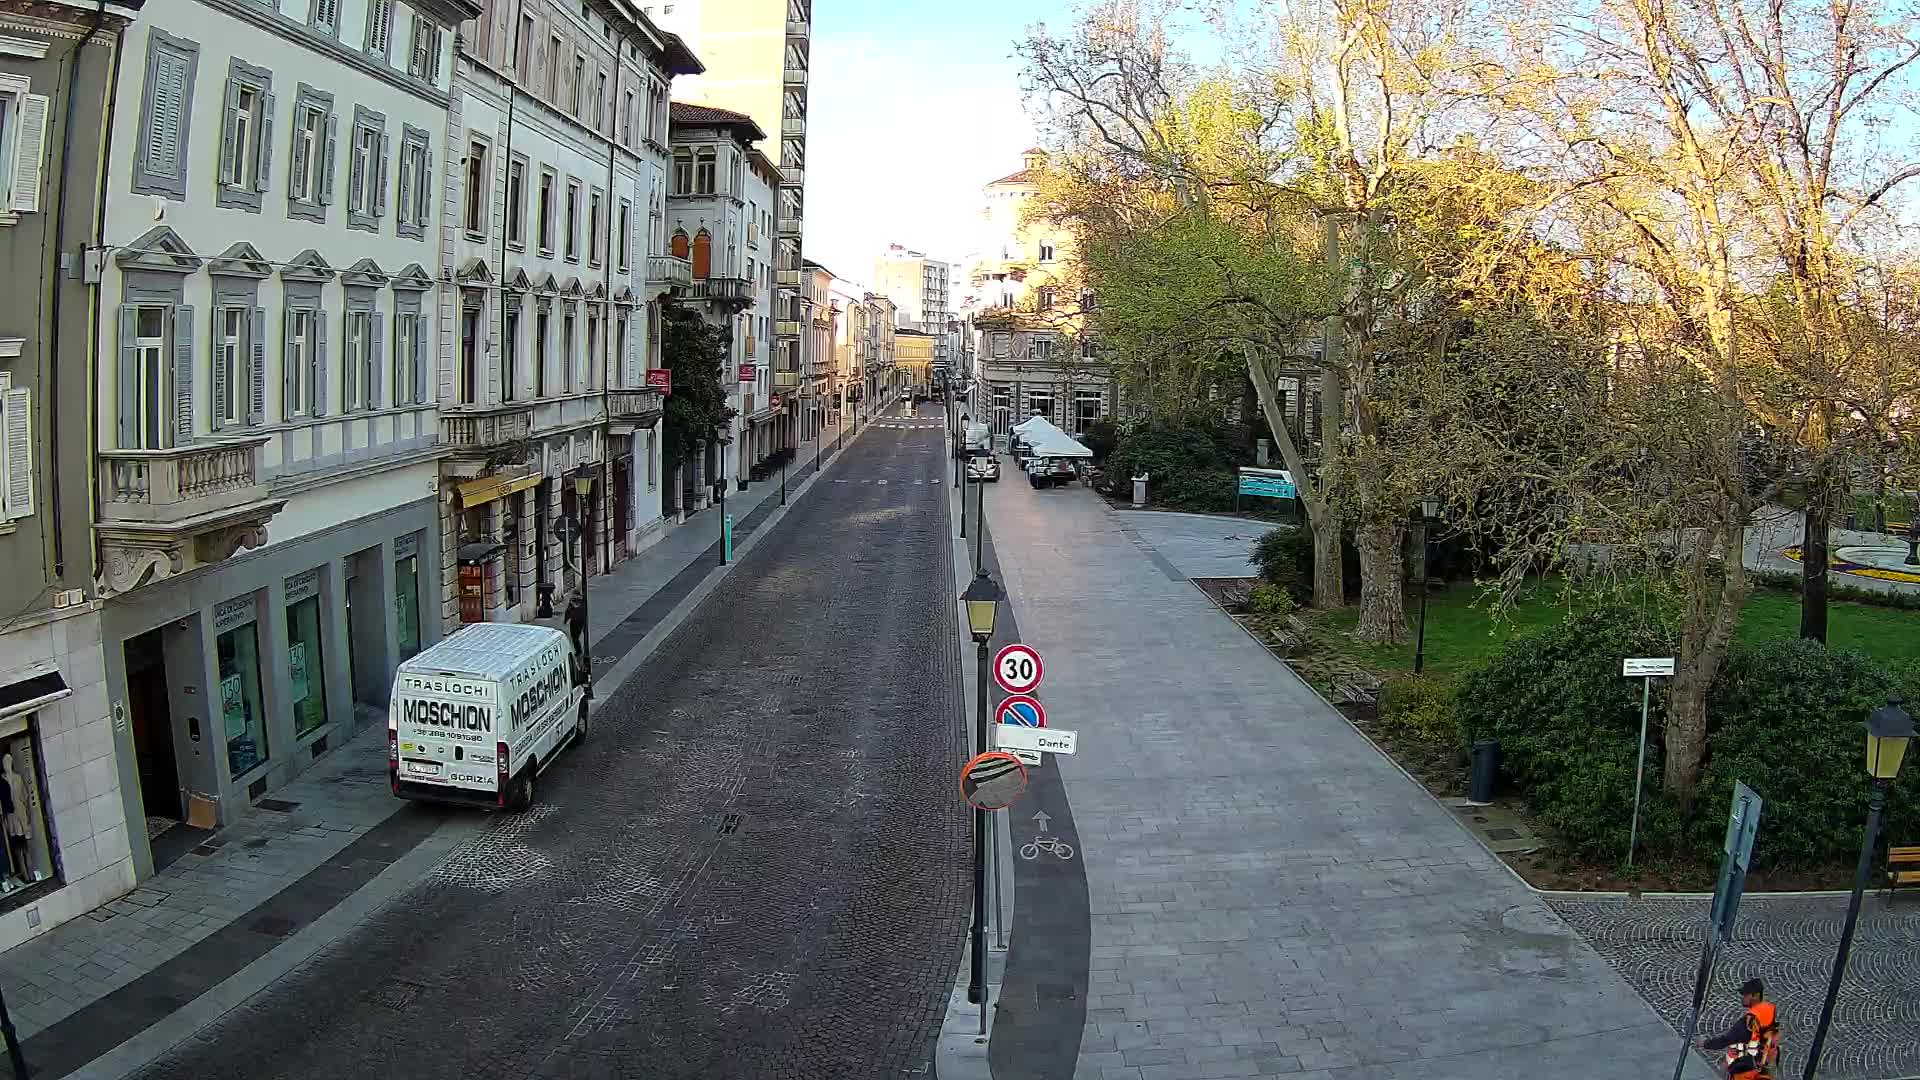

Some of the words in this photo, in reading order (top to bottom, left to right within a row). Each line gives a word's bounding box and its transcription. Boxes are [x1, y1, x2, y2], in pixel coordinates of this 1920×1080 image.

[510, 643, 562, 690] TRASLOCHI
[1005, 658, 1033, 680] 30
[405, 678, 488, 697] TRASLOCHI
[510, 661, 567, 732] MOSCHION
[403, 699, 491, 733] MOSCHION
[1038, 738, 1069, 749] Dante
[451, 773, 495, 785] GORIZIA
